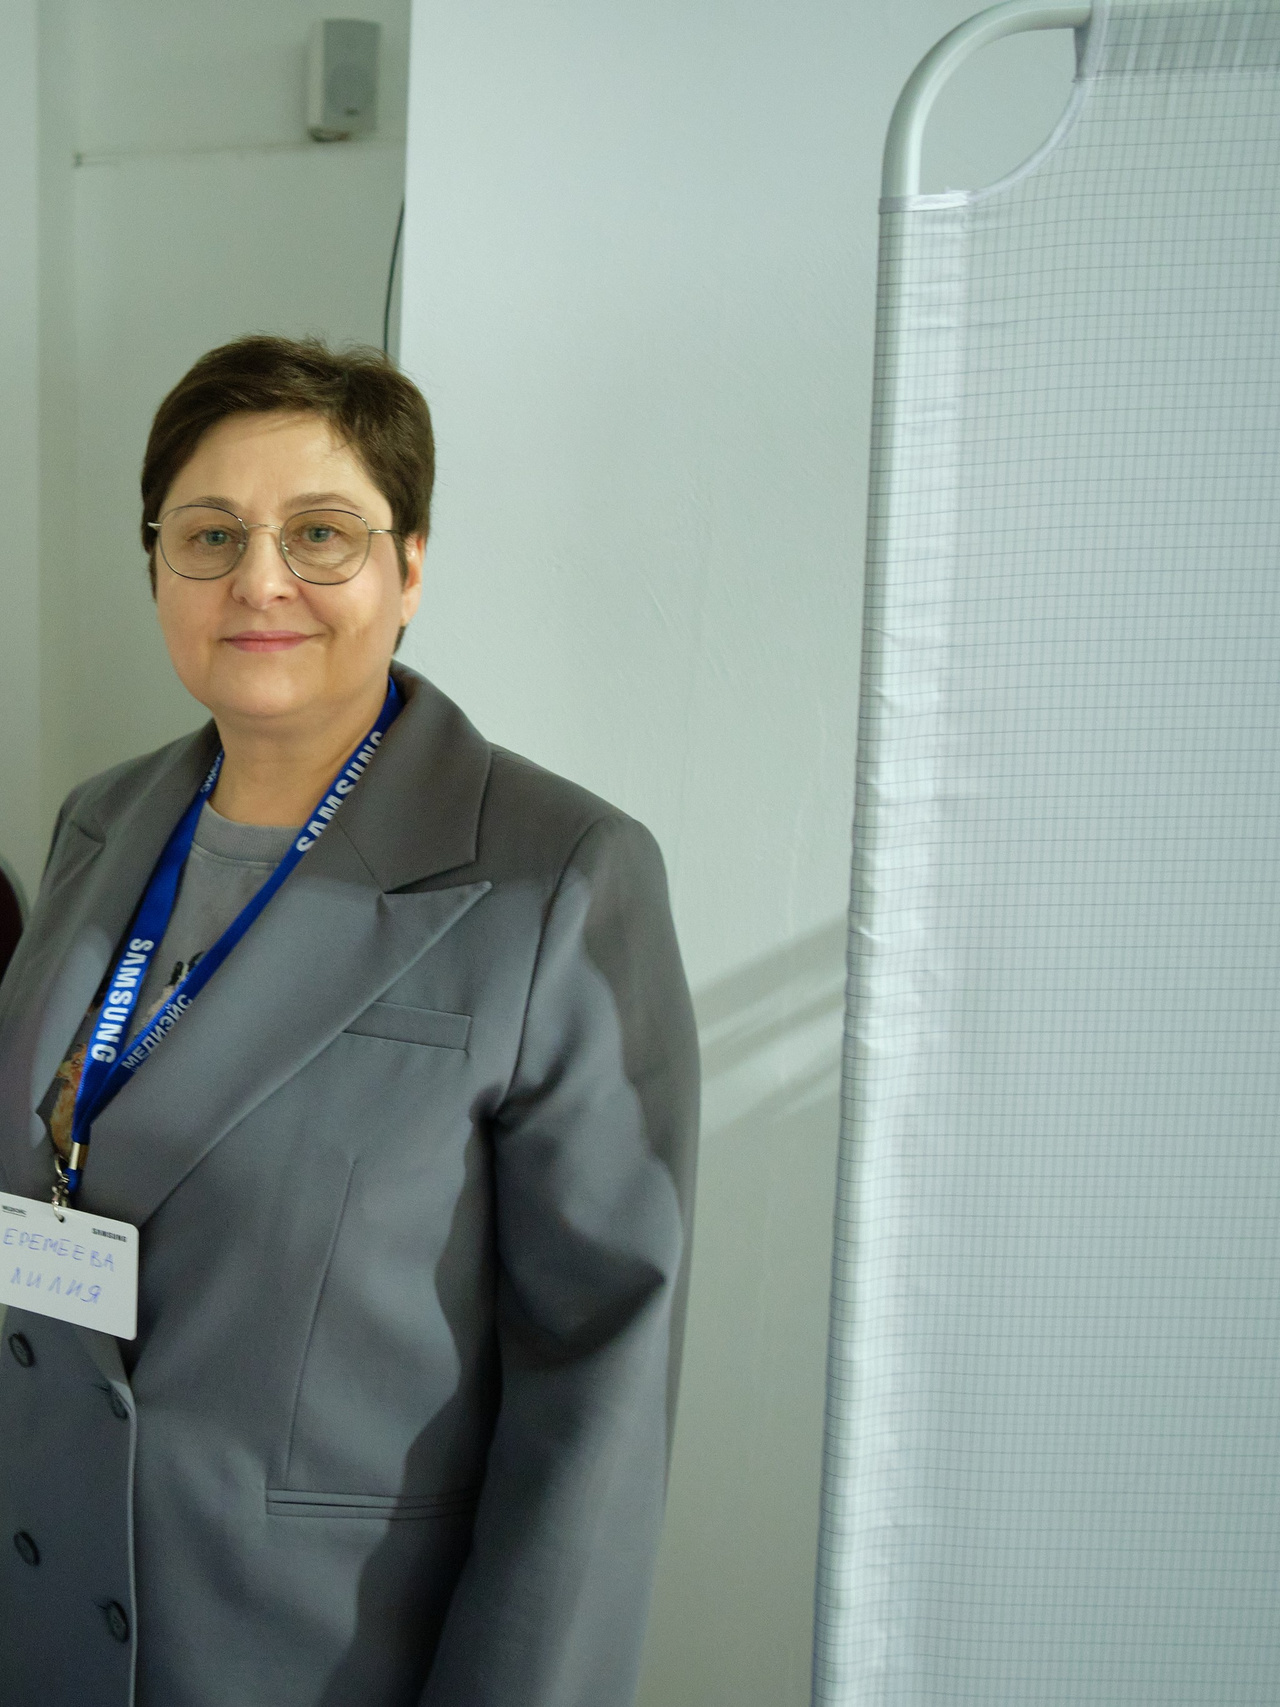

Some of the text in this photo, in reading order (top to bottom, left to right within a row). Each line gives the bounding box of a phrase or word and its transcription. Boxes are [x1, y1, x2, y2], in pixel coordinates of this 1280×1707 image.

[295, 730, 382, 852] SAMSUNG
[90, 938, 154, 1064] SAMSUNG
[2, 1227, 115, 1273] ЕРЕМЕЕВА
[9, 1266, 103, 1304] ЛИЛИЯ
